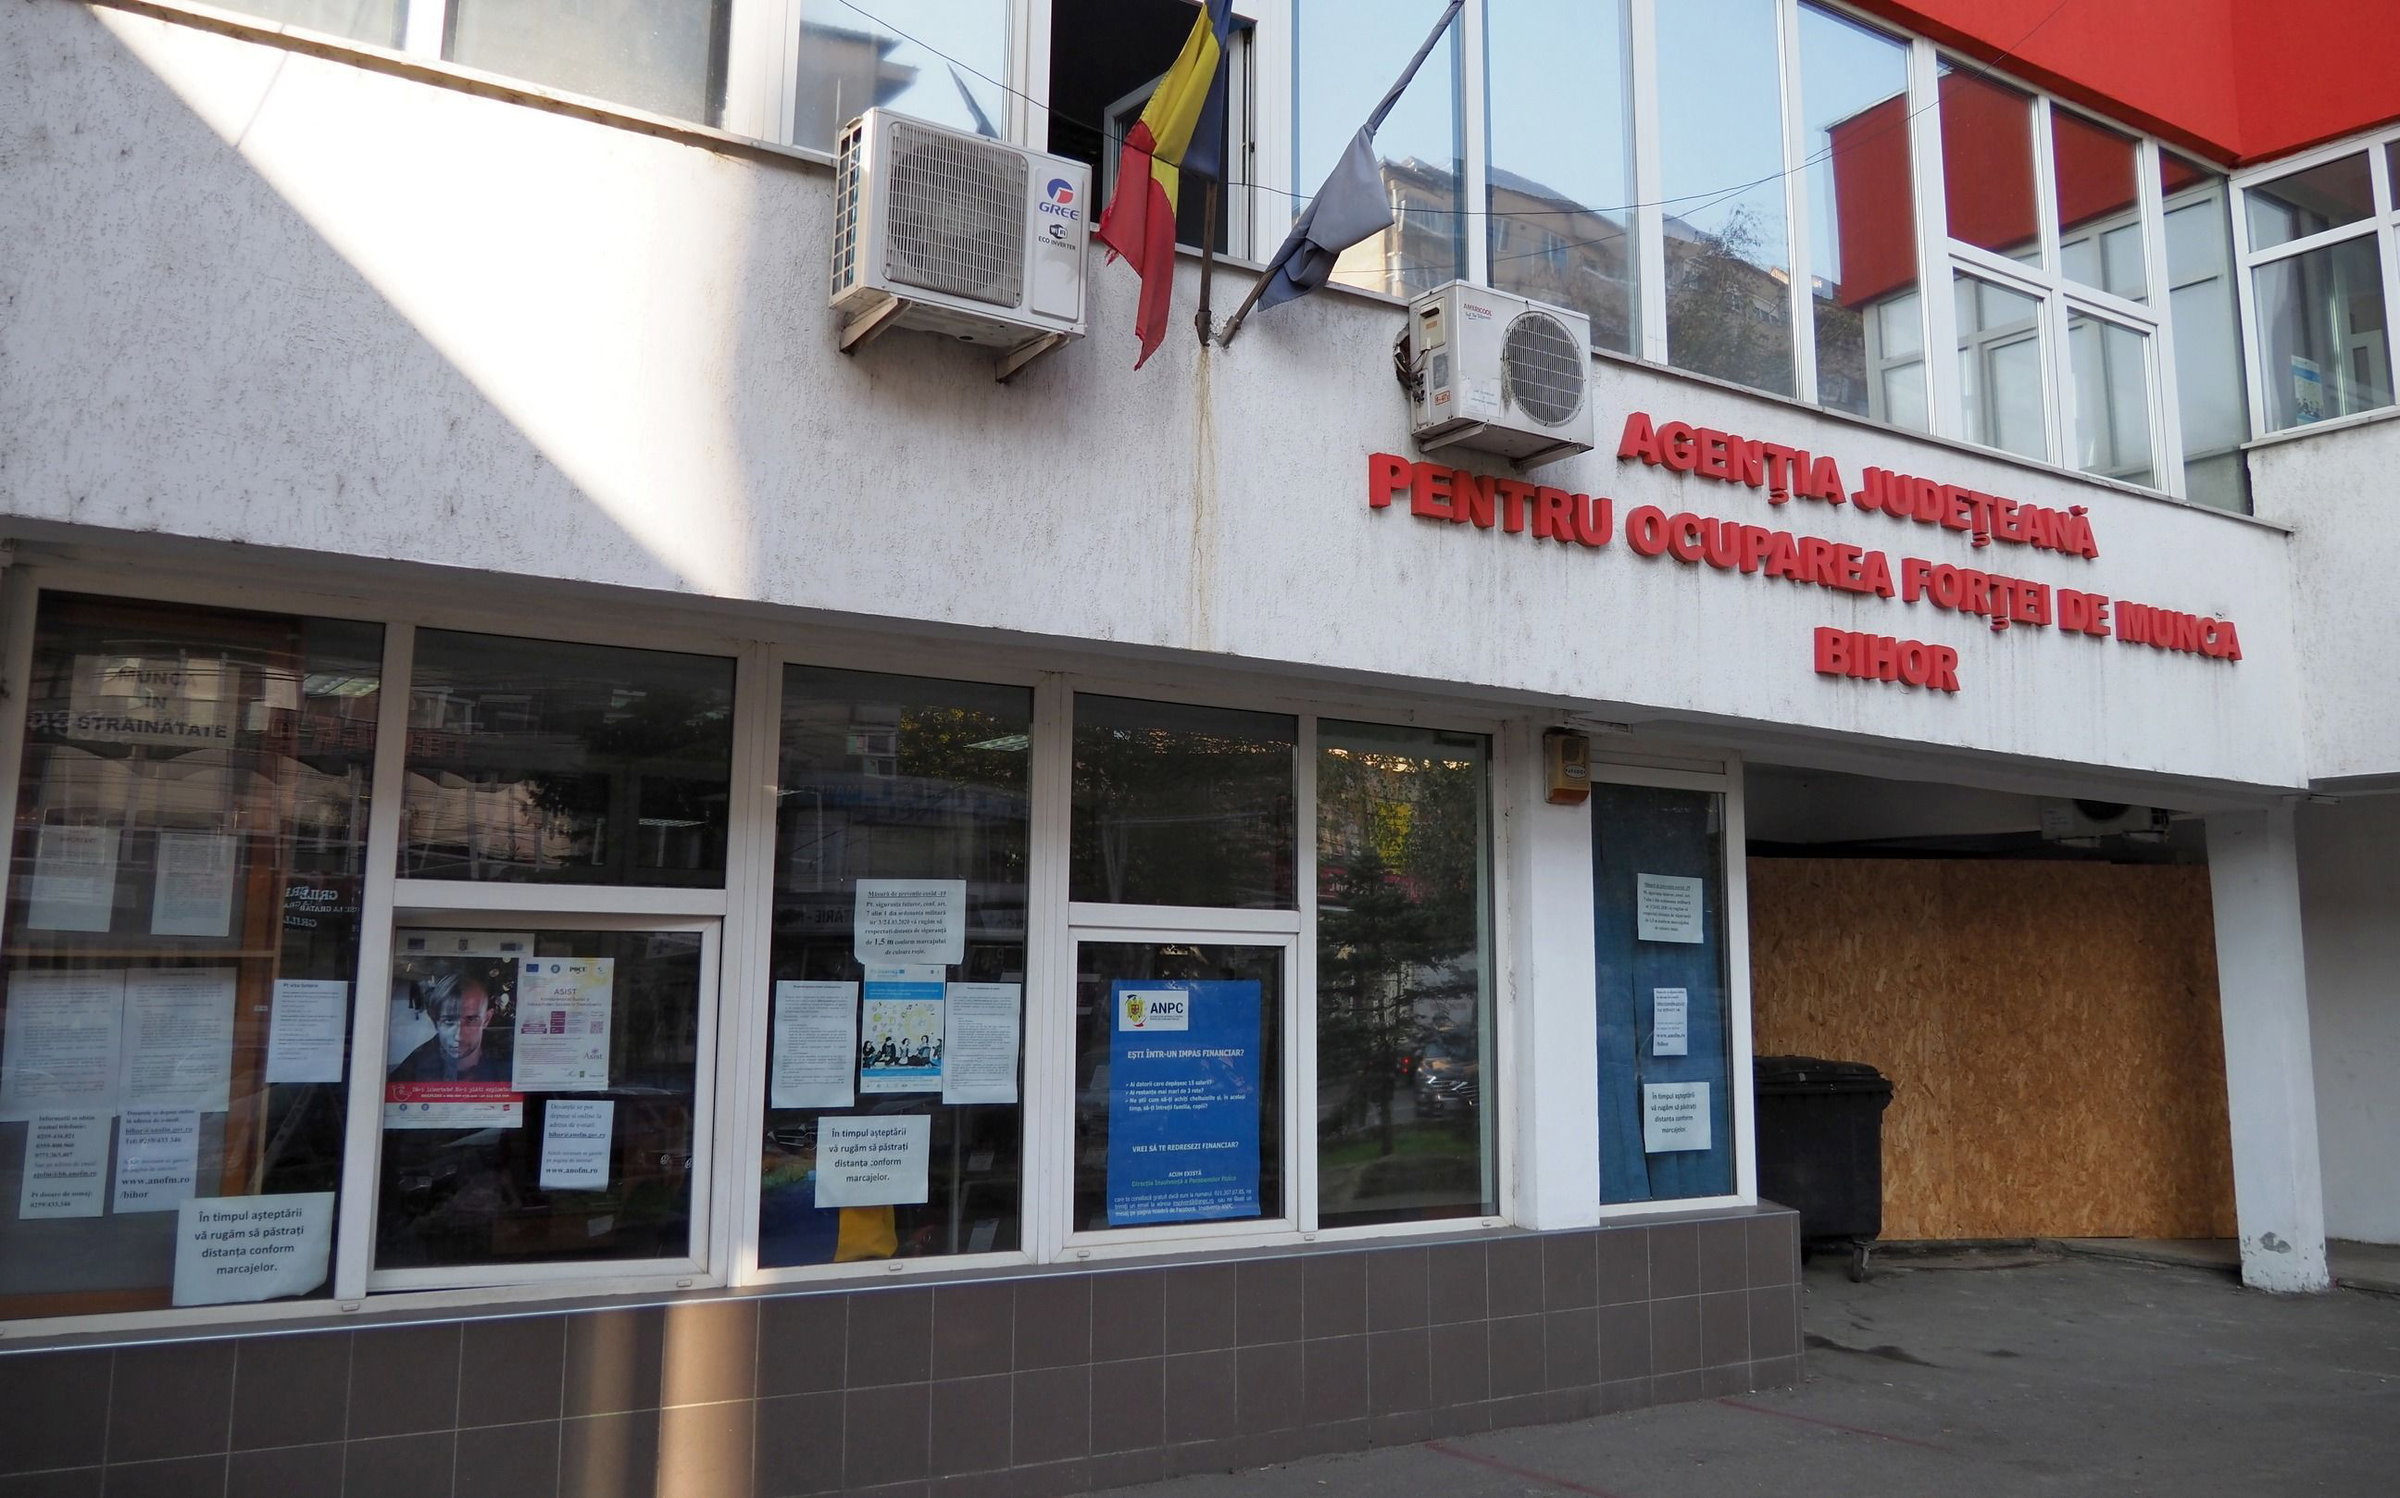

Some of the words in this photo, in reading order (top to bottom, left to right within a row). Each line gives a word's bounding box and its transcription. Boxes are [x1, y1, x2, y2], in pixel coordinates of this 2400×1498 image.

[1039, 201, 1080, 221] GREE
[1038, 235, 1050, 244] ECO
[1368, 452, 1613, 547] PENTRU
[1625, 505, 1895, 597] OCUPAREA
[2057, 588, 2111, 637] DE
[1814, 626, 1961, 693] BIHOR
[1150, 1002, 1184, 1014] ANPC
[1146, 1048, 1178, 1059] ÎNTR-UN
[1178, 1049, 1201, 1058] IMPAS
[1202, 1048, 1245, 1057] FINANCIAR?
[831, 1128, 840, 1138] În
[842, 1128, 869, 1139] timpul
[870, 1127, 907, 1138] așteptării
[840, 1144, 867, 1154] rugăm
[868, 1143, 877, 1152] să
[878, 1142, 909, 1153] păstrați
[1132, 1145, 1148, 1153] VREI
[1158, 1144, 1167, 1152] TE
[1167, 1142, 1201, 1152] REDRESEZI
[1201, 1141, 1239, 1150] FINANCIAR?
[546, 1166, 599, 1174] www.anofm.ro
[834, 1160, 868, 1168] distanța
[122, 1176, 190, 1185] www.anofm.ro
[846, 1173, 890, 1183] marcajelor.
[198, 1211, 210, 1223] În
[212, 1210, 249, 1223] timpul
[251, 1207, 303, 1222] așteptării
[194, 1230, 207, 1241] vă
[210, 1230, 246, 1241] rugăm
[248, 1228, 260, 1238] să
[262, 1225, 304, 1239] păstrați
[201, 1248, 247, 1258] distanța
[249, 1244, 295, 1256] conform
[216, 1262, 278, 1275] marcajelor.
